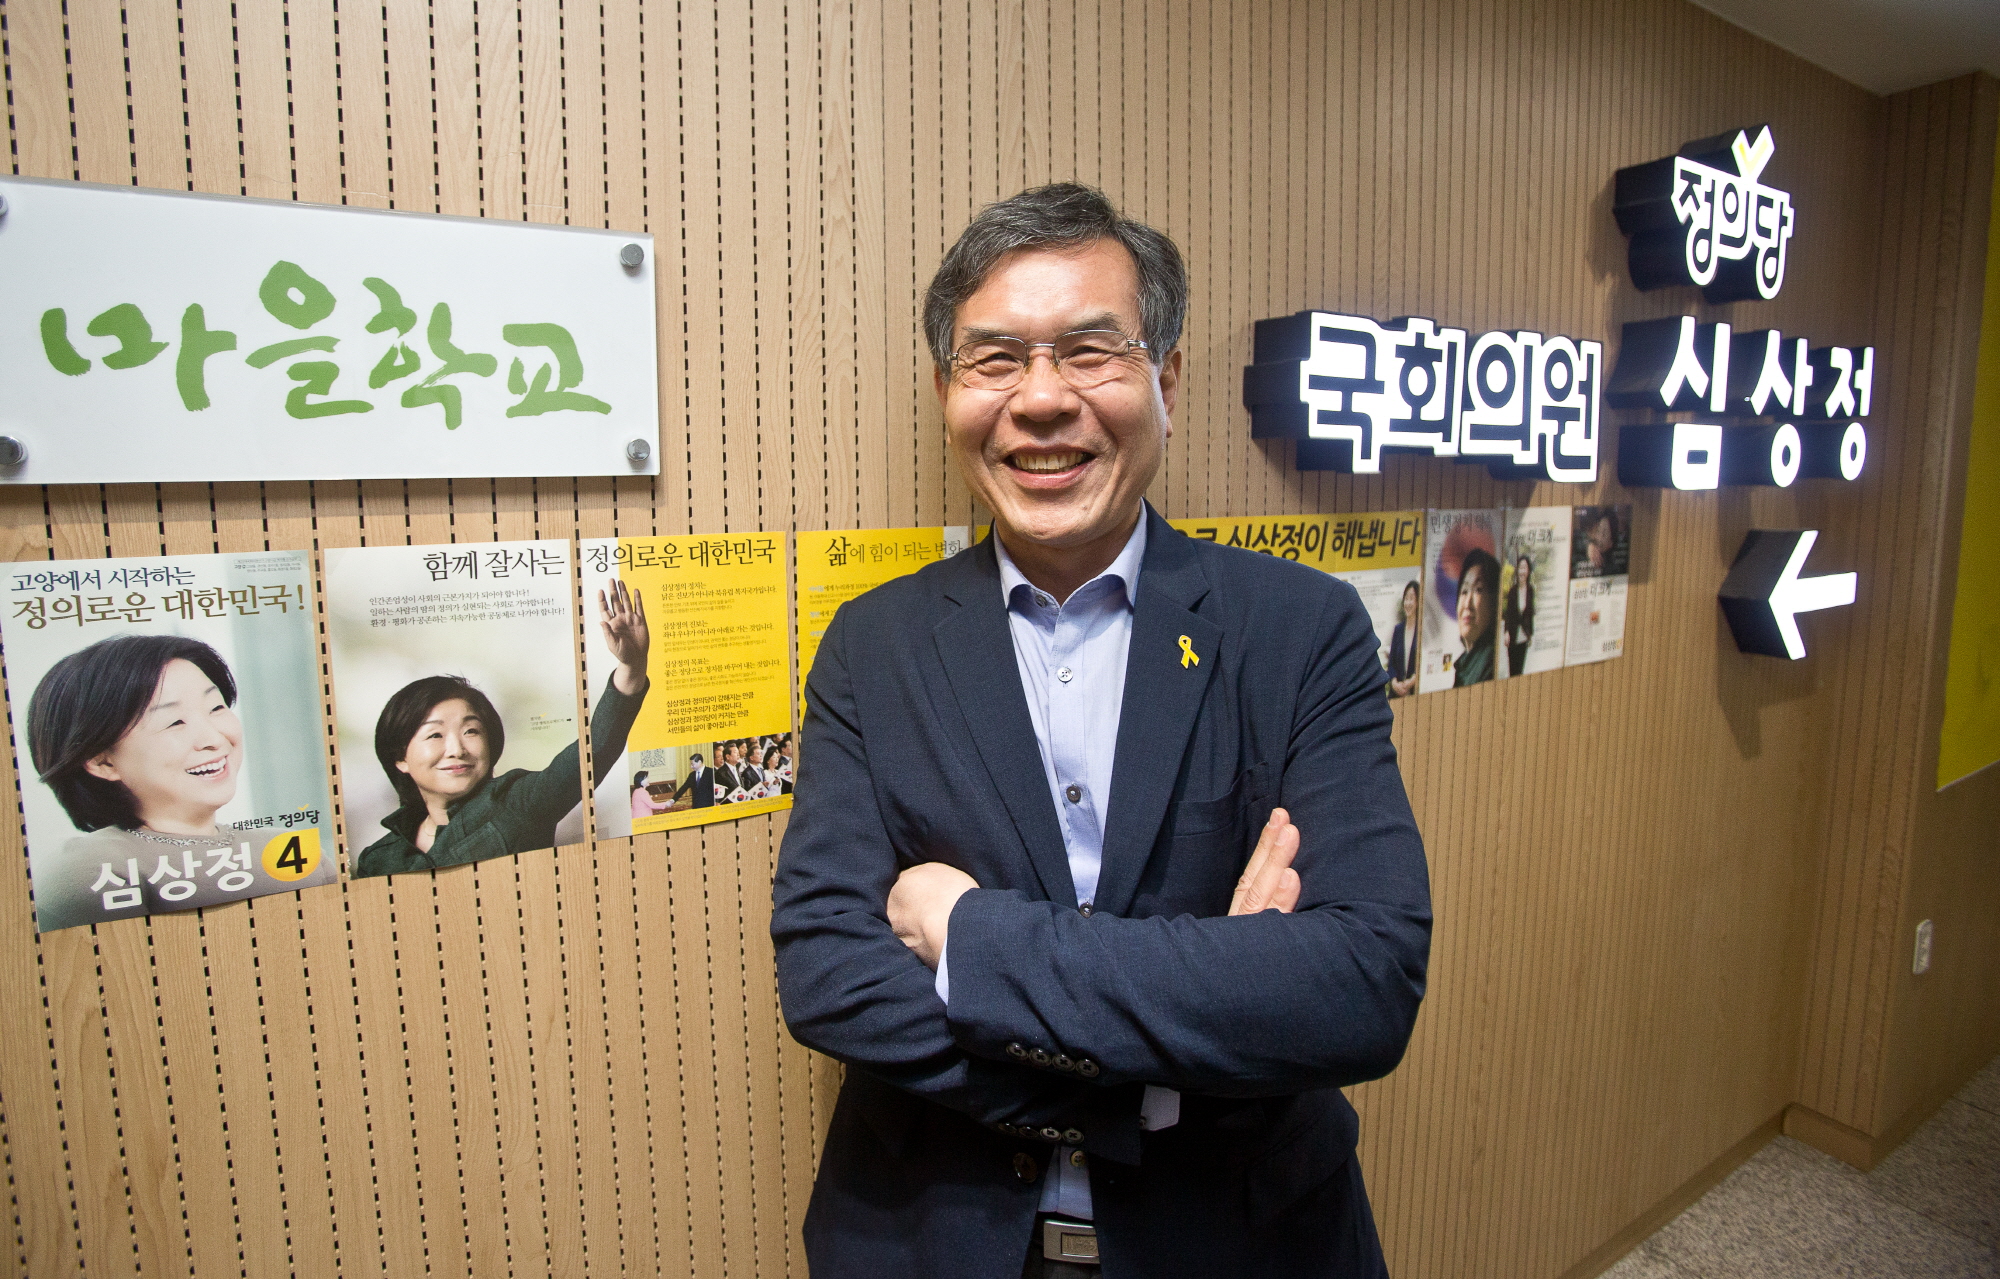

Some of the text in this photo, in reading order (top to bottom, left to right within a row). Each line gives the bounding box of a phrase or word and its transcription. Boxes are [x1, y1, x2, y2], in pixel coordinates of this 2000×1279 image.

[1671, 154, 1795, 300] 정의당
[41, 260, 612, 431] 마을학교
[1301, 312, 1875, 491] 국회의원 심상정
[1331, 517, 1422, 560] 해냅니다
[586, 538, 776, 572] 정의로운 대한민국
[824, 536, 964, 567] 삶에 힘이 되는 변화
[422, 548, 565, 582] 함께 잘사는
[11, 566, 196, 592] 고양에서 시작하는
[661, 582, 707, 592] 심상정의 정치는
[418, 594, 440, 602] 사회의
[442, 592, 480, 602] 근본가치가
[482, 590, 503, 599] 되어야
[504, 588, 530, 598] 합니다!
[676, 591, 694, 600] 진보가
[696, 590, 714, 598] 아니라
[12, 584, 305, 630] 정의로운 대한민국!
[370, 608, 394, 616] 일하는
[396, 606, 418, 615] 사람의
[438, 604, 460, 612] 정의가
[462, 602, 492, 611] 실현되는
[492, 601, 514, 609] 사회로
[416, 616, 448, 625] 공존하는
[449, 612, 486, 622] 지속가능한
[487, 611, 516, 620] 공동체로
[518, 608, 539, 618] 나가야
[540, 608, 565, 616] 합니다!
[663, 620, 708, 630] 심상정의 진보는
[697, 628, 716, 636] 아니라
[664, 658, 710, 669] 심상정의 목표는
[680, 667, 703, 676] 정당으로
[705, 664, 723, 674] 정치를
[666, 691, 754, 708] 심상정과 정의당이 강해지는 만큼
[666, 708, 680, 716] 우리
[680, 706, 711, 716] 민주주의가
[667, 710, 750, 726] 심상정과 정의당이 커지는 만큼
[668, 725, 692, 735] 서민들의
[693, 723, 706, 732] 삶이
[232, 809, 320, 832] 대한민국 정의당
[276, 836, 308, 874] 4
[90, 842, 255, 910] 심상정
